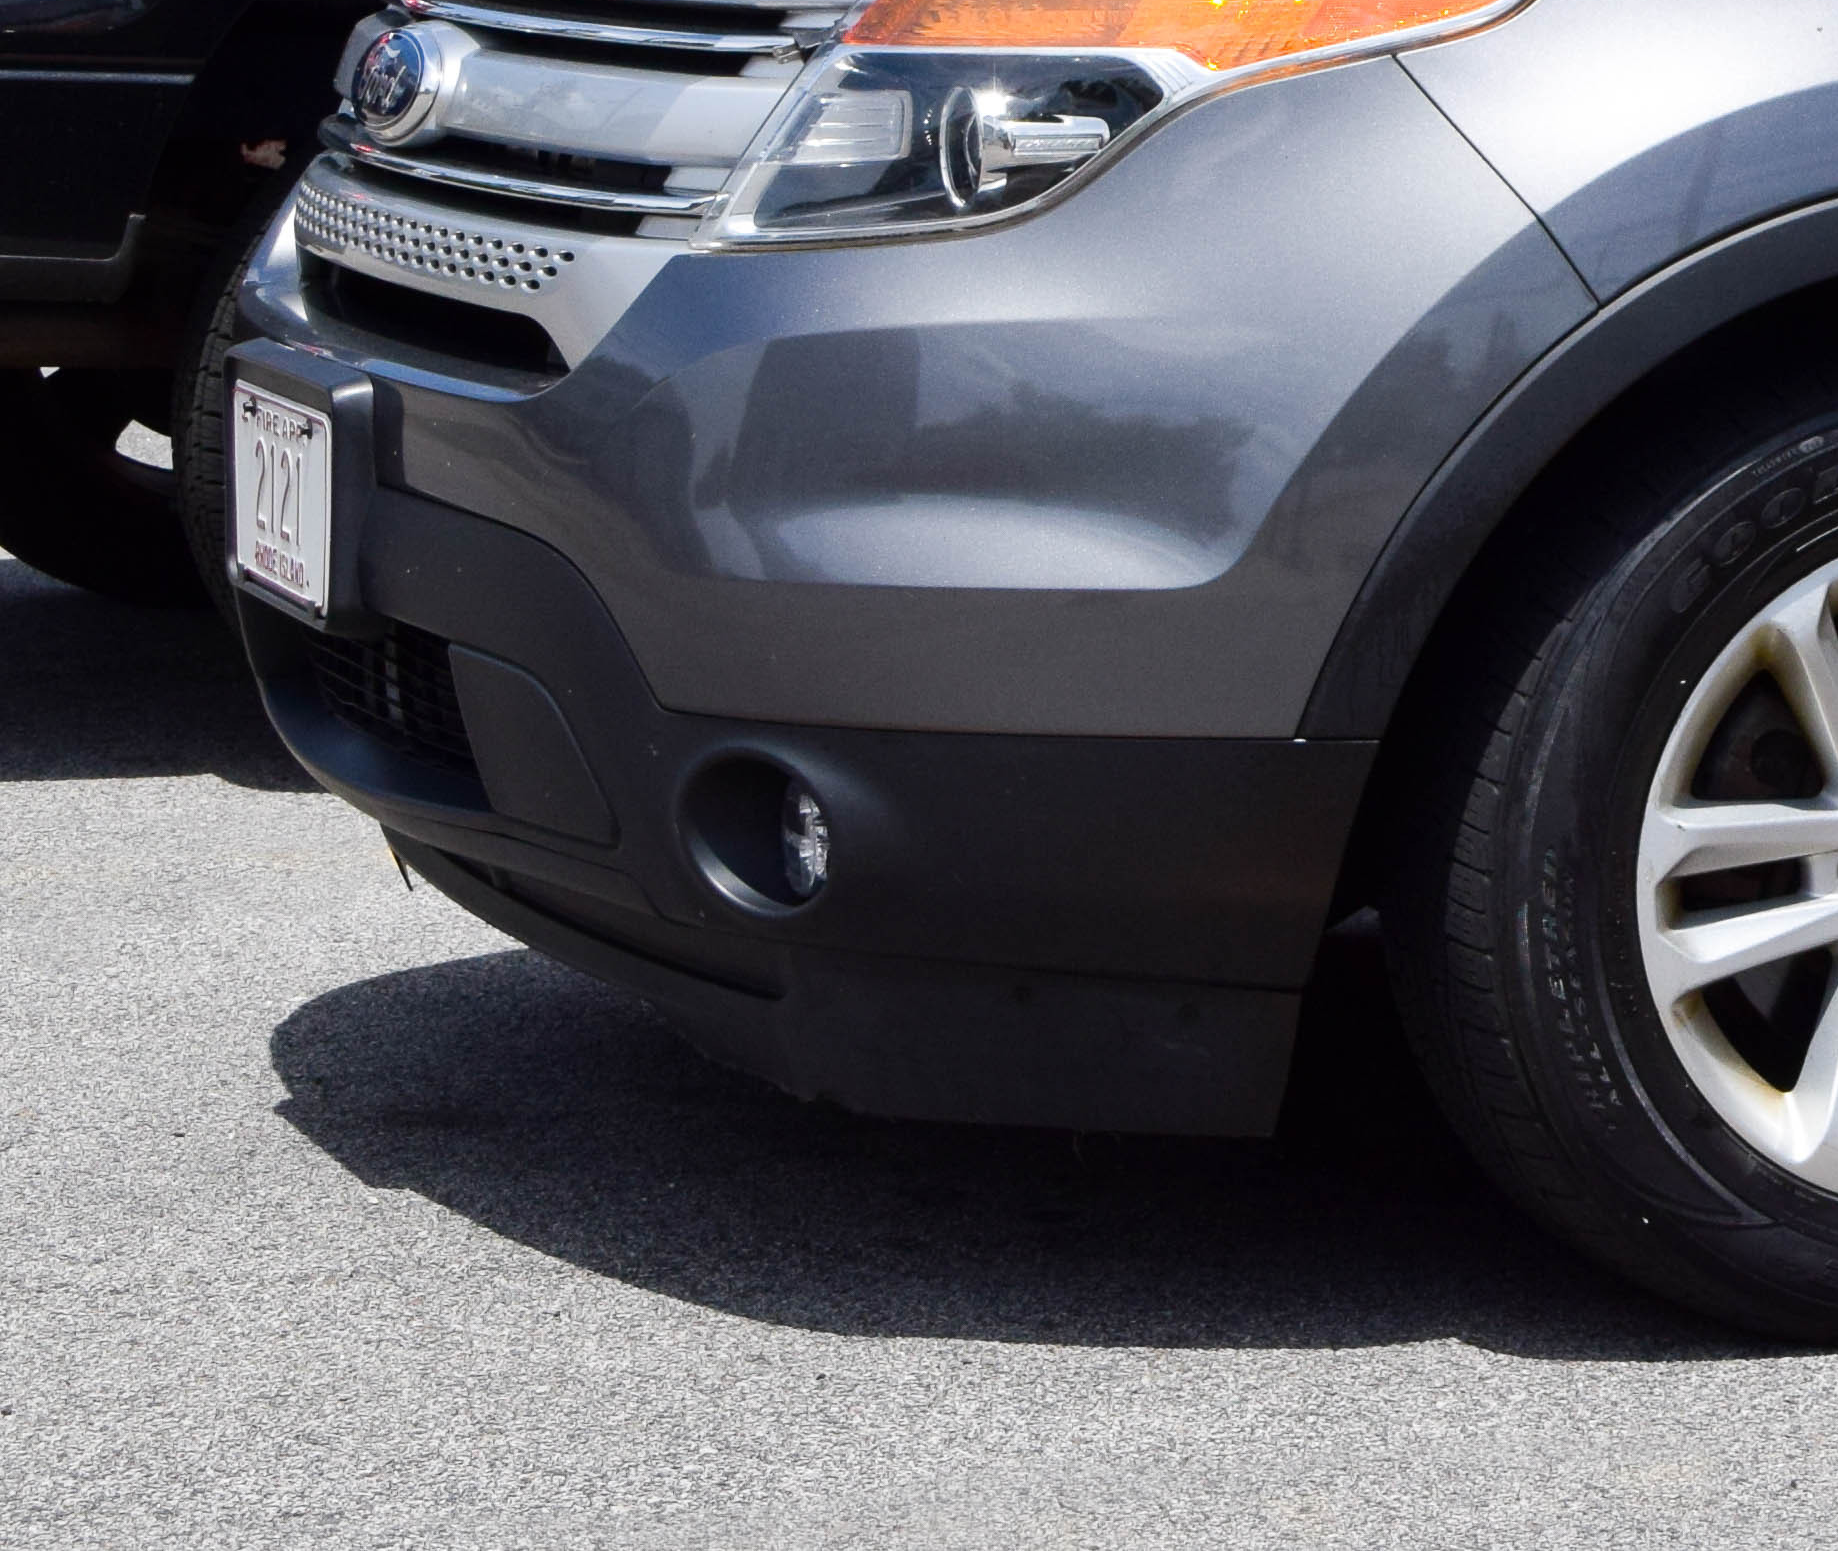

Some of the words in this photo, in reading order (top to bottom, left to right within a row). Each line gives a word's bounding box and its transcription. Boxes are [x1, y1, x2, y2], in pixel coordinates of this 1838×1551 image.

[256, 406, 281, 438] FIRE
[255, 437, 303, 547] 2121
[255, 539, 278, 576] RHODE
[279, 551, 305, 589] ISLAND
